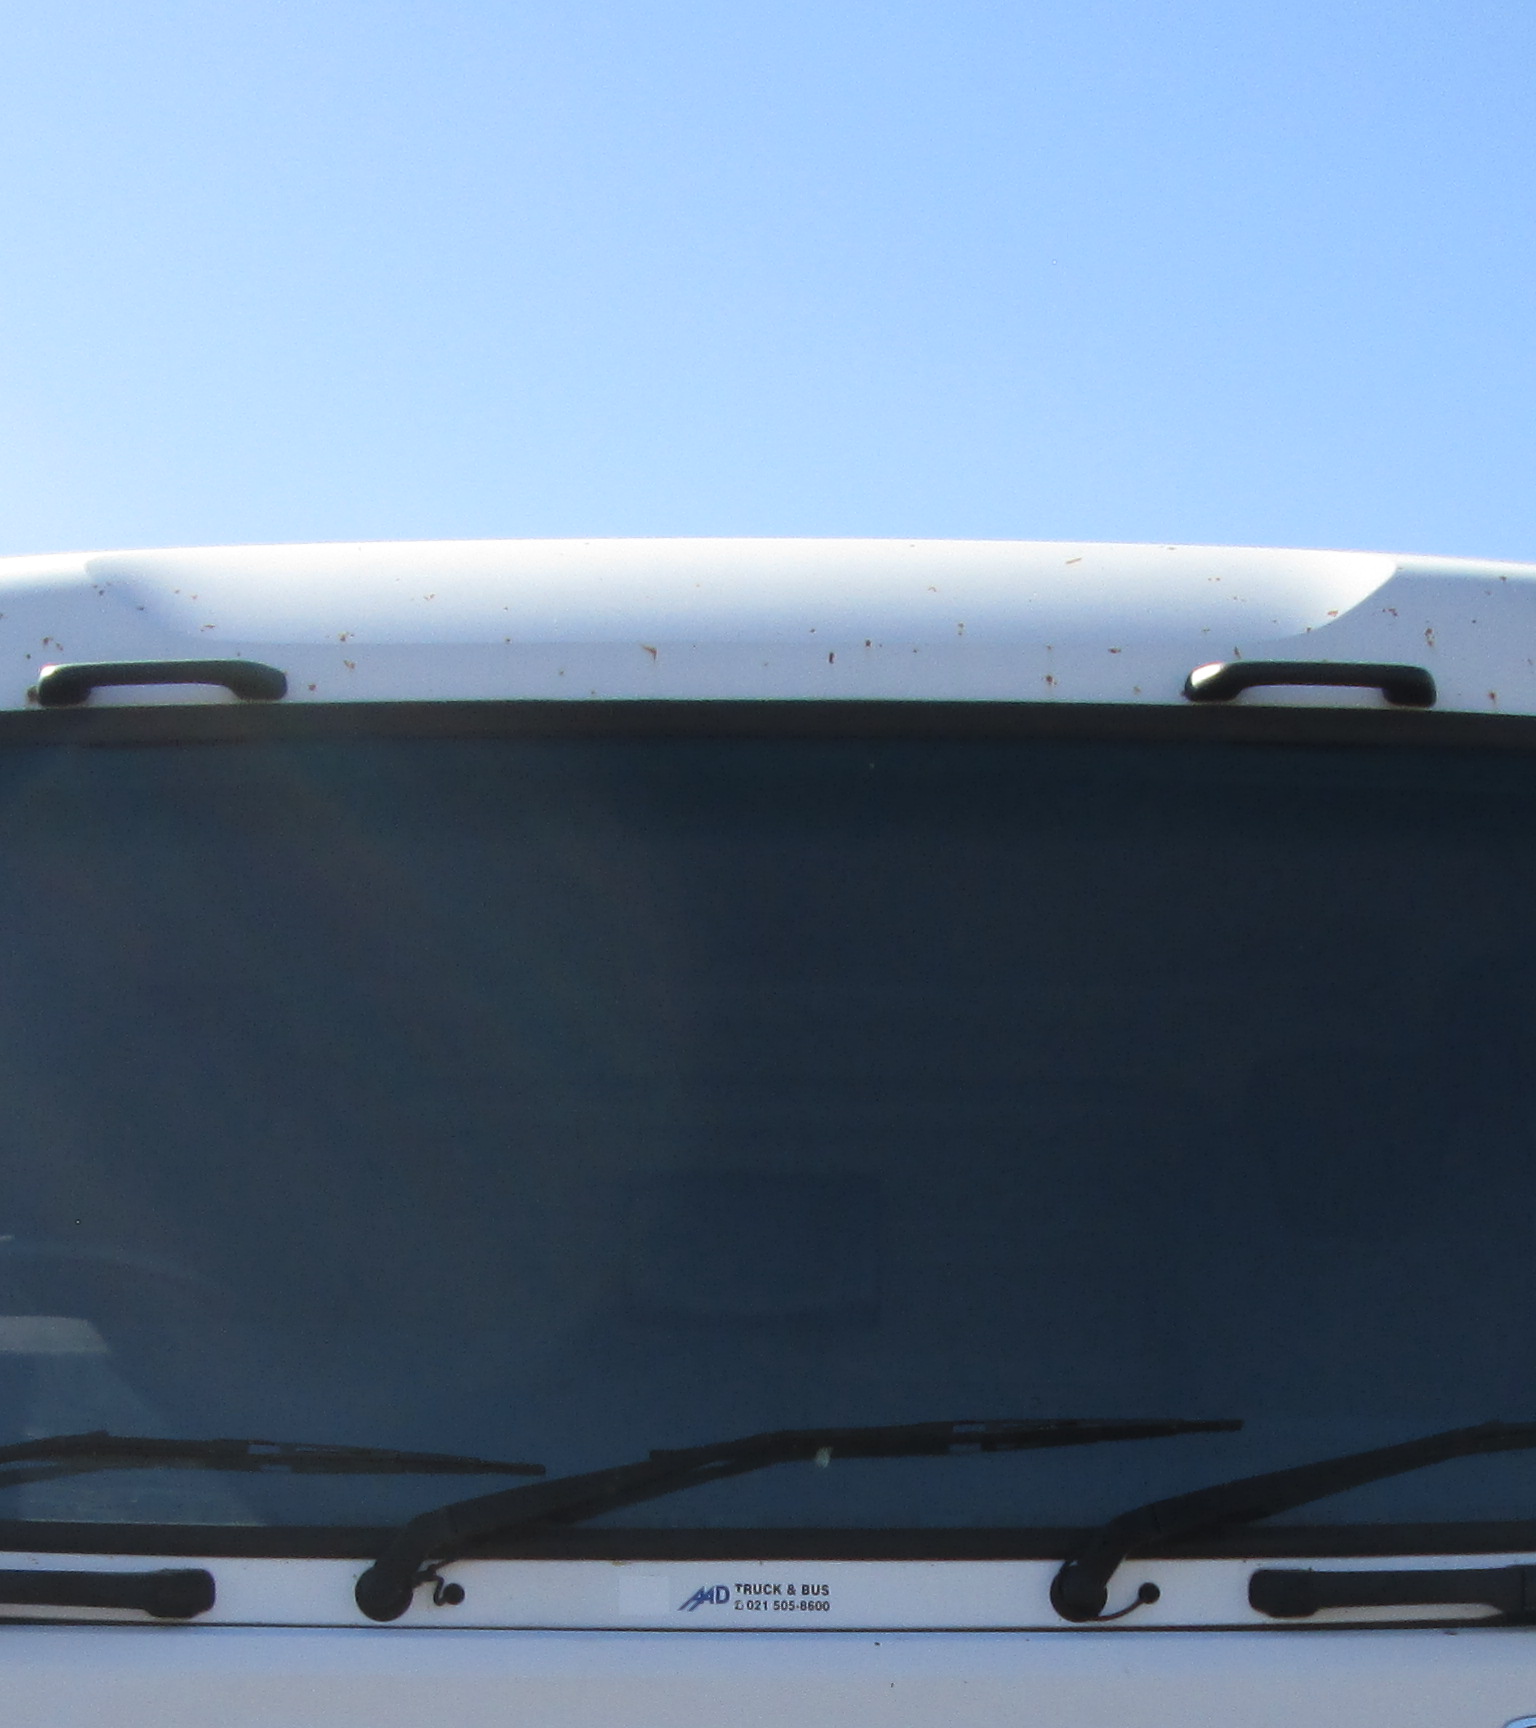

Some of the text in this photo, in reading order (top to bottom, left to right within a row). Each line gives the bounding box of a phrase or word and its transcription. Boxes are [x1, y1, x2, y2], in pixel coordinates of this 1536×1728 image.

[734, 1583, 830, 1596] TRUCK & BUS
[746, 1600, 831, 1612] 021 505-8600
